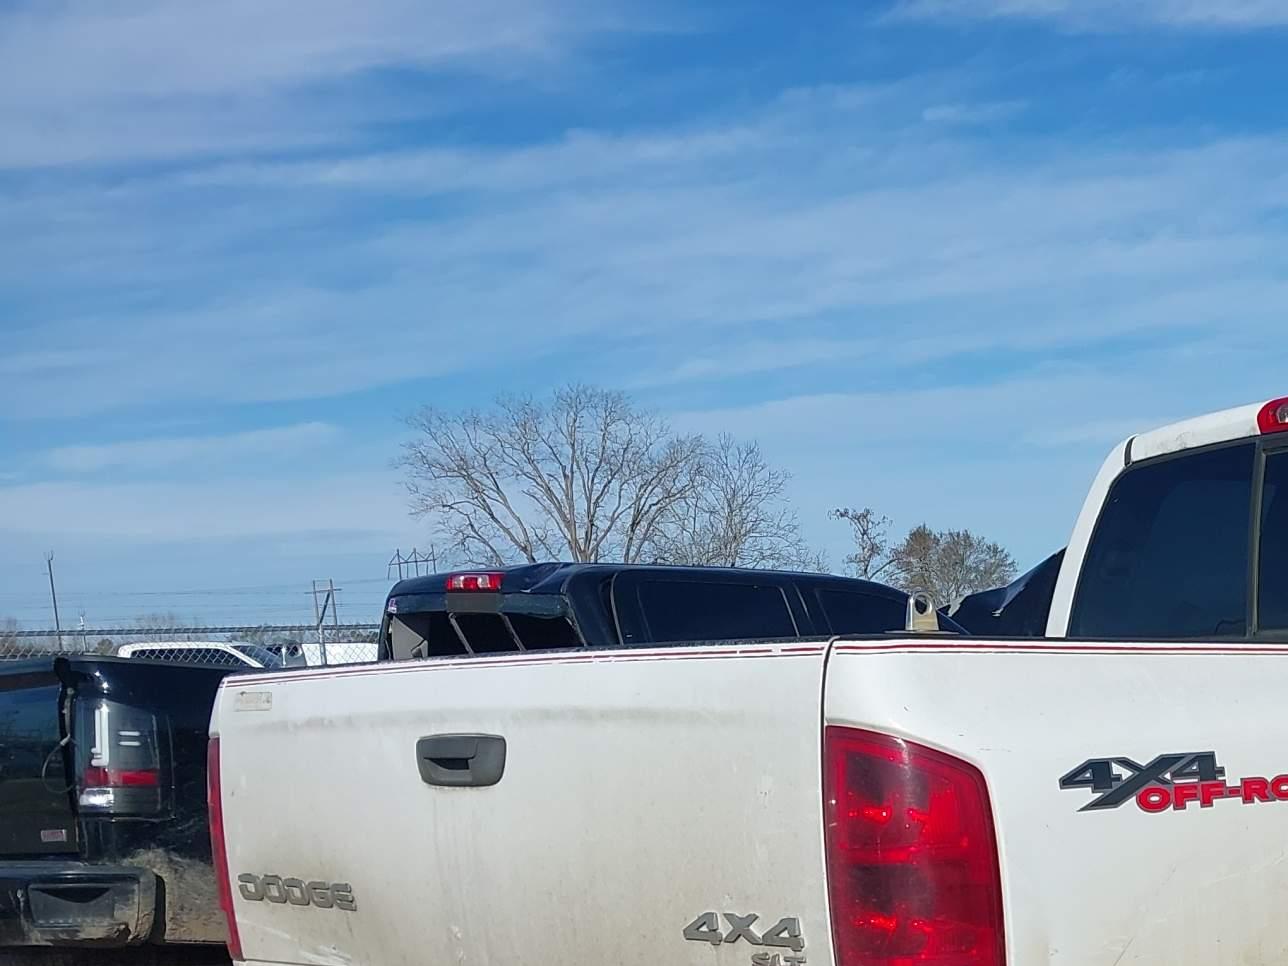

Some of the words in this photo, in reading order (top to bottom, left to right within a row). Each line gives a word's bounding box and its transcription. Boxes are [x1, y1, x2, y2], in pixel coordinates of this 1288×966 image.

[1059, 751, 1225, 812] 4X4
[238, 873, 358, 912] DODGE
[683, 912, 805, 951] 4X4
